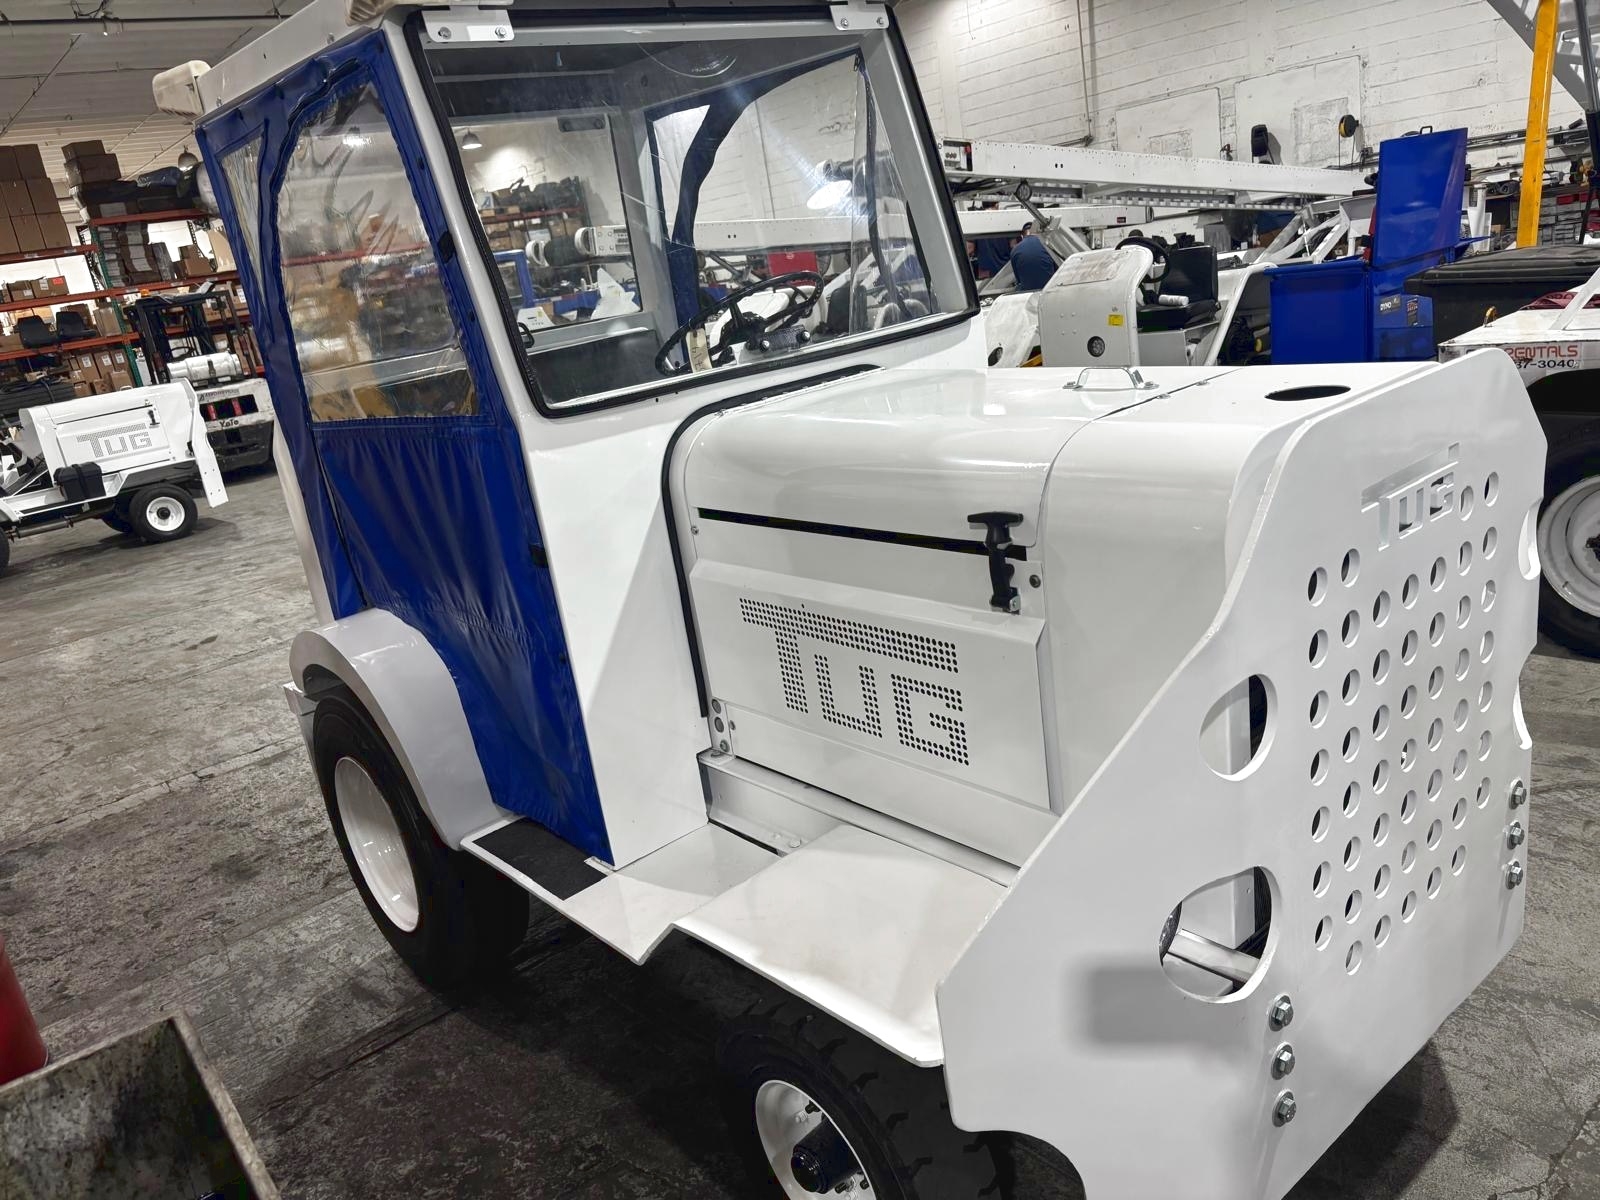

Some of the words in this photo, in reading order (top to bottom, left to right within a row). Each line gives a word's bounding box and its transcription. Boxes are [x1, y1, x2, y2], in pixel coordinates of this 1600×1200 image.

[1505, 345, 1578, 359] RENTALS
[76, 423, 152, 457] TUG
[1361, 441, 1459, 551] TUG
[739, 597, 969, 766] TUG
